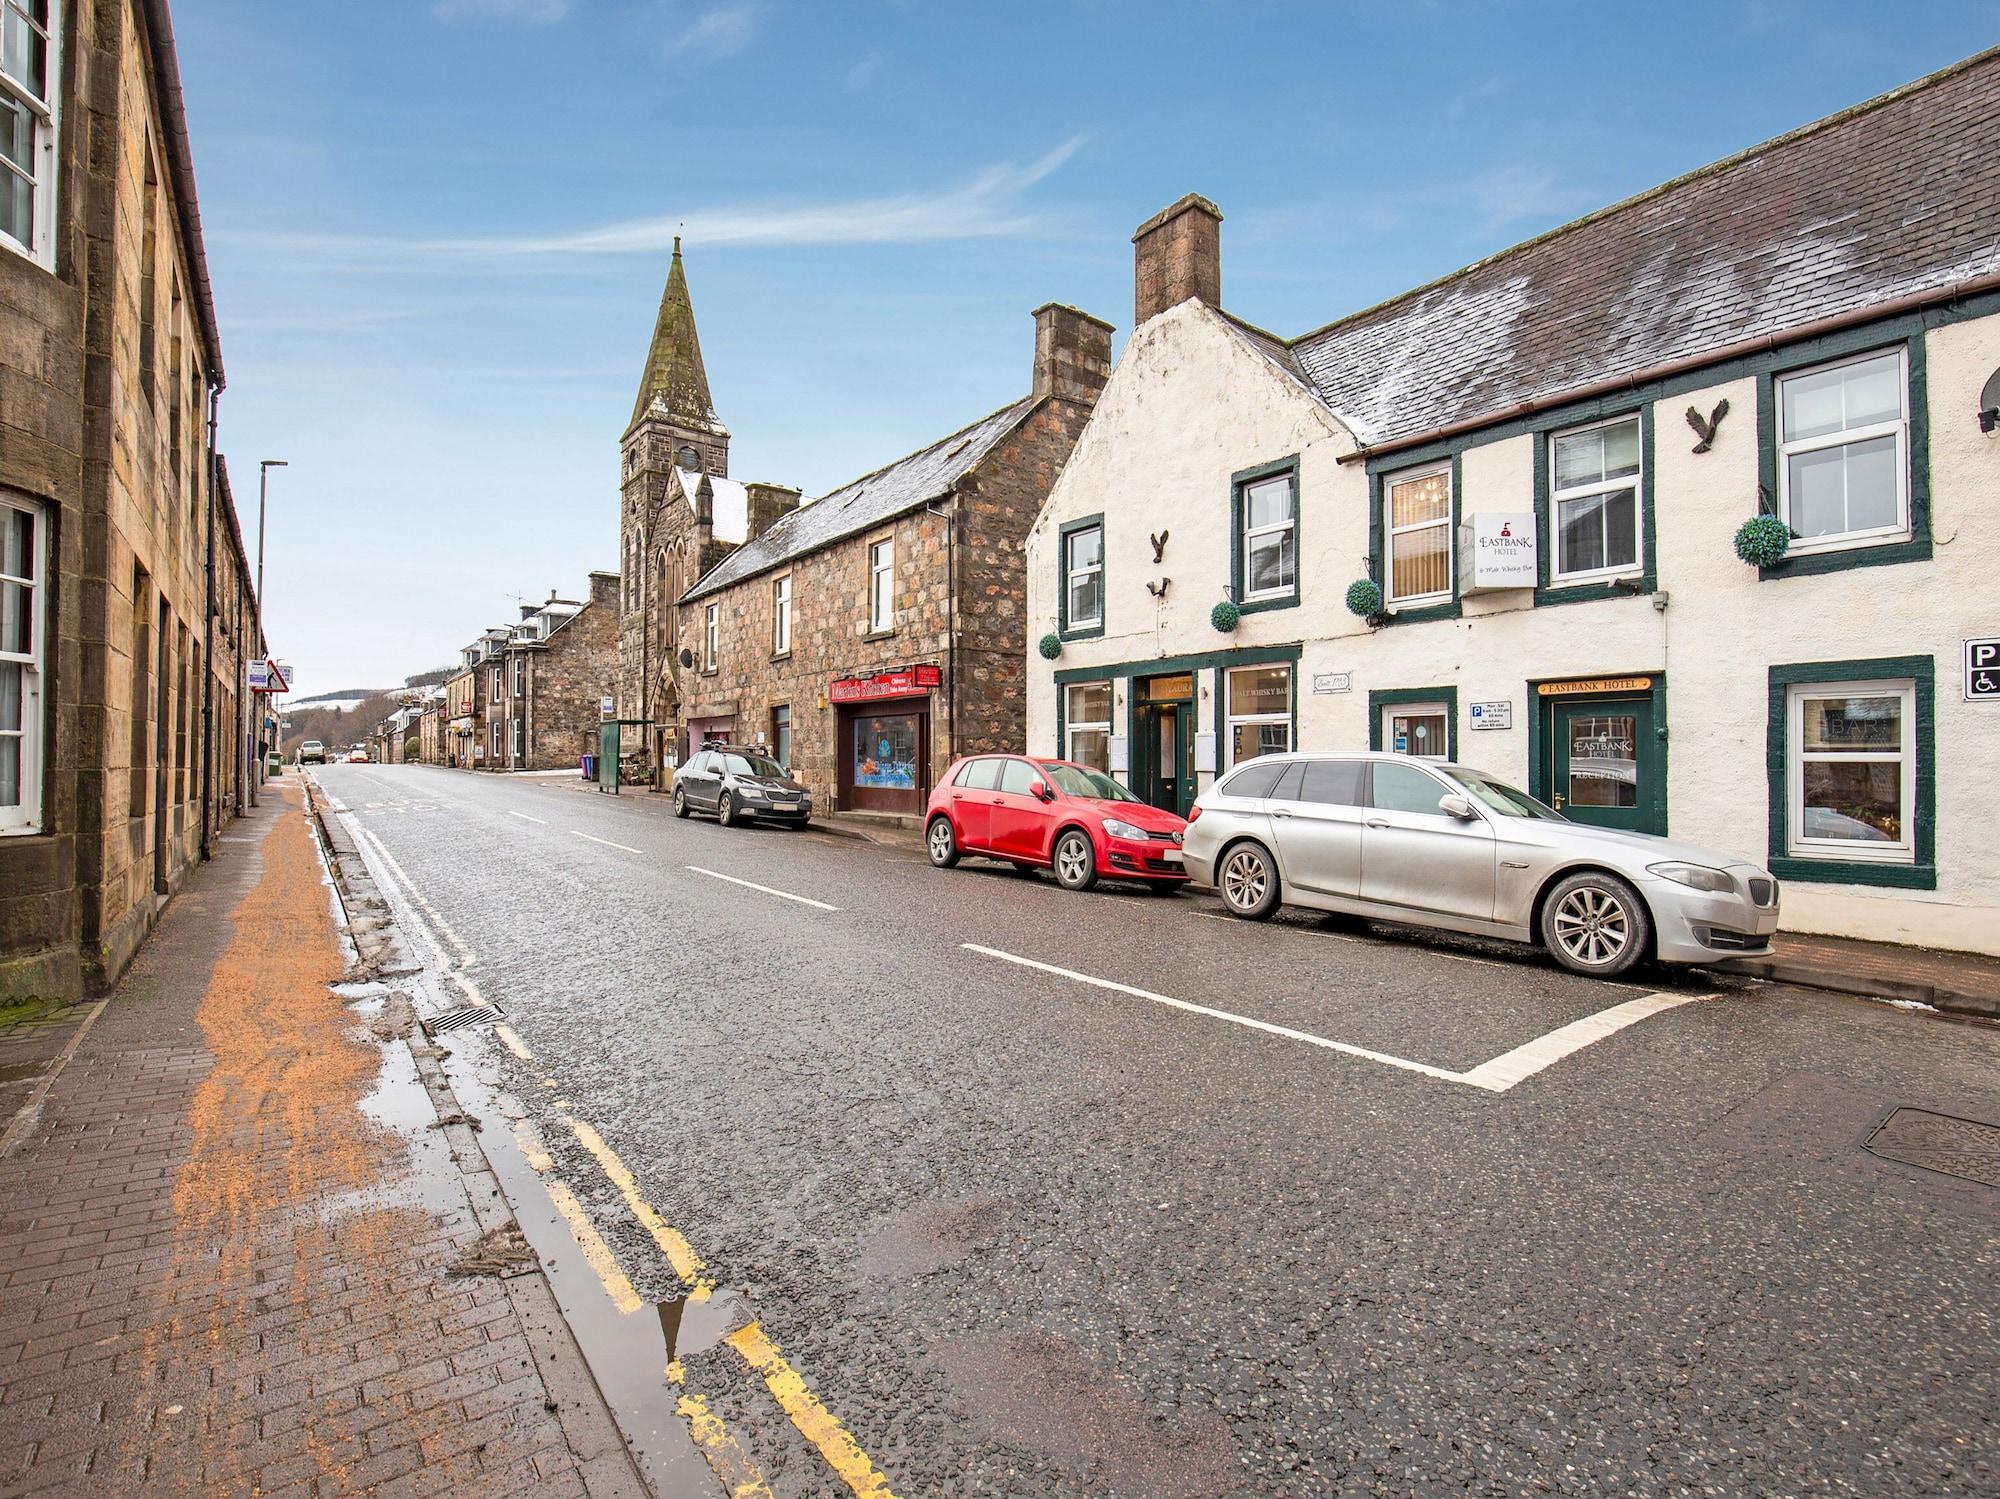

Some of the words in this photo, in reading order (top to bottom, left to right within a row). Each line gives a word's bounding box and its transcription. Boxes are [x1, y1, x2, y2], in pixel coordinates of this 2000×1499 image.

[1480, 537, 1532, 548] EASTBANK
[1976, 646, 1996, 666] P
[1549, 682, 1599, 693] EASTBANK
[1604, 680, 1638, 689] HOTEL
[1832, 719, 1878, 734] BAR
[1573, 741, 1633, 752] EASTBANK
[1590, 750, 1616, 758] HOTEL
